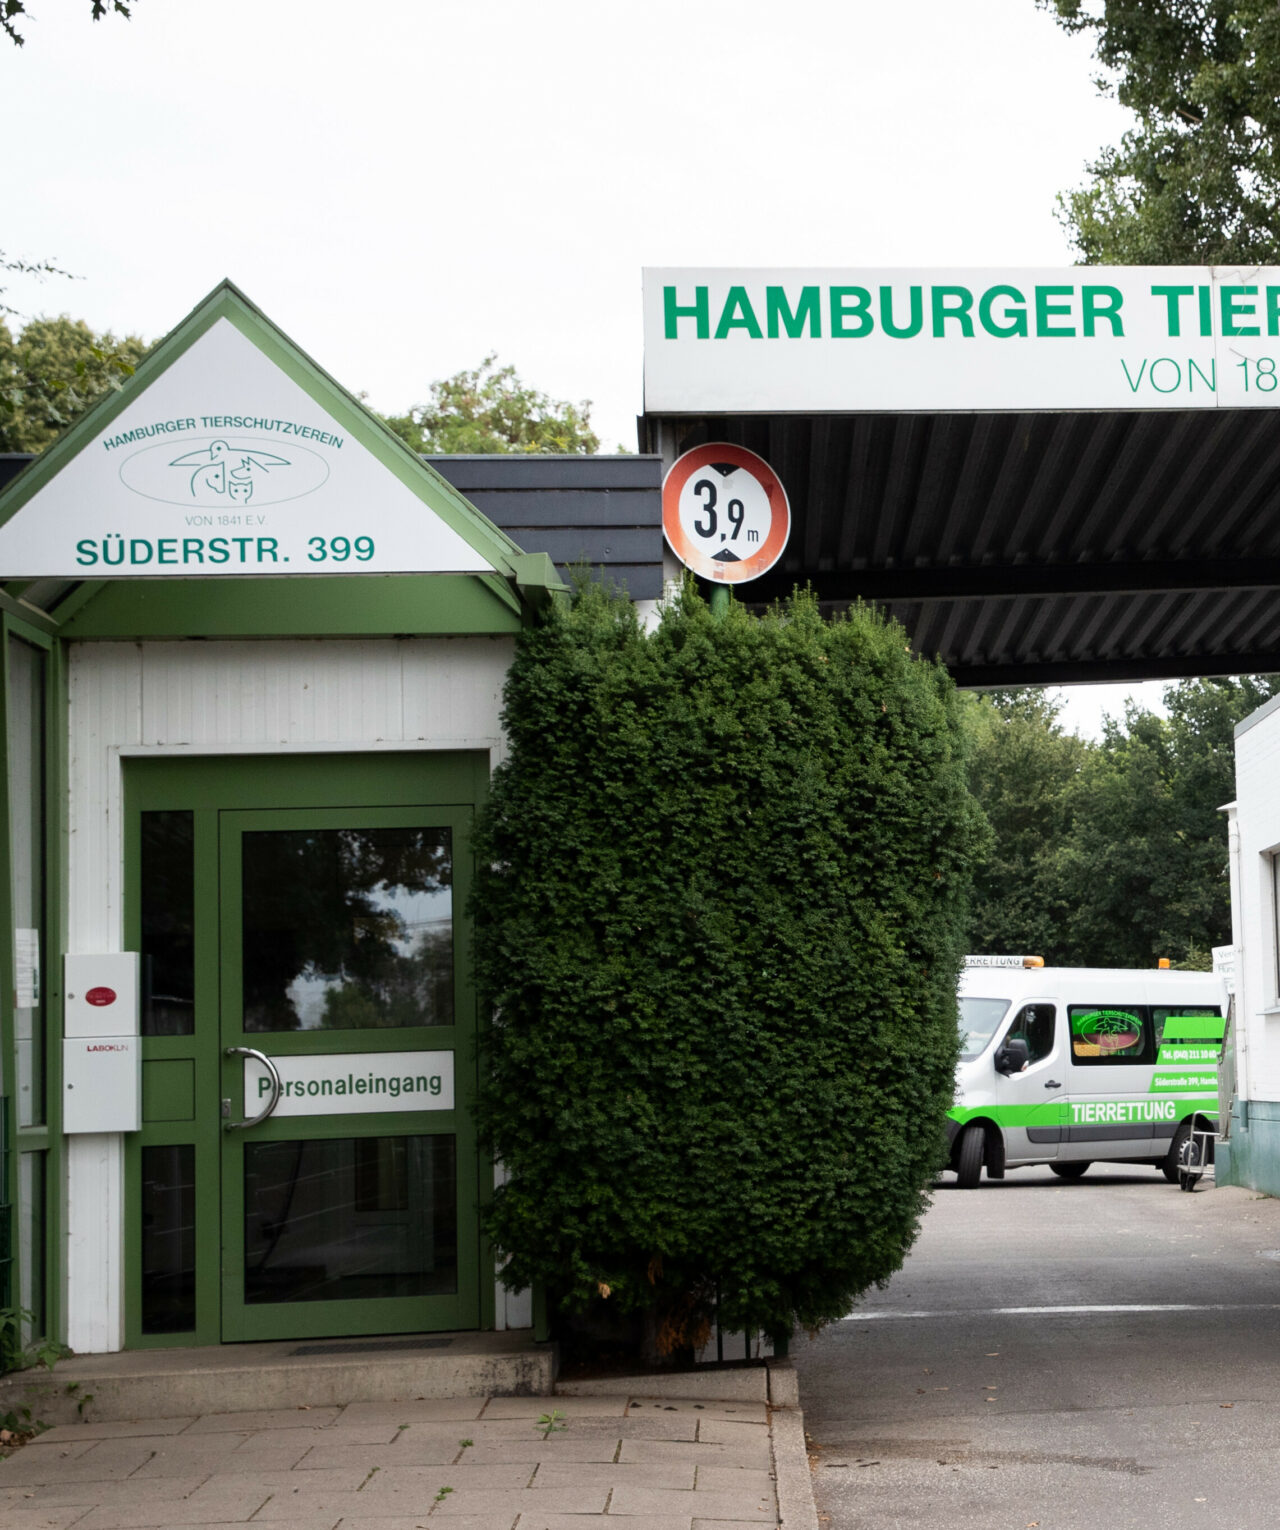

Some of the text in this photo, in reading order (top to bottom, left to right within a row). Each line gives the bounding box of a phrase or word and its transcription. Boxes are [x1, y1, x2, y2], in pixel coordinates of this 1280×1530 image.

[663, 284, 1125, 340] HAMBURGER
[1120, 357, 1218, 393] VON
[103, 415, 345, 451] HAMBURGER TIERSCHUTZVEREIN
[185, 515, 268, 527] VON 1841 E.V.
[694, 479, 759, 543] 3,9 m
[76, 533, 375, 566] SÜDERSTR. 399
[257, 1072, 442, 1098] Personaleingang
[1072, 1101, 1176, 1123] TIERRETTUNG
